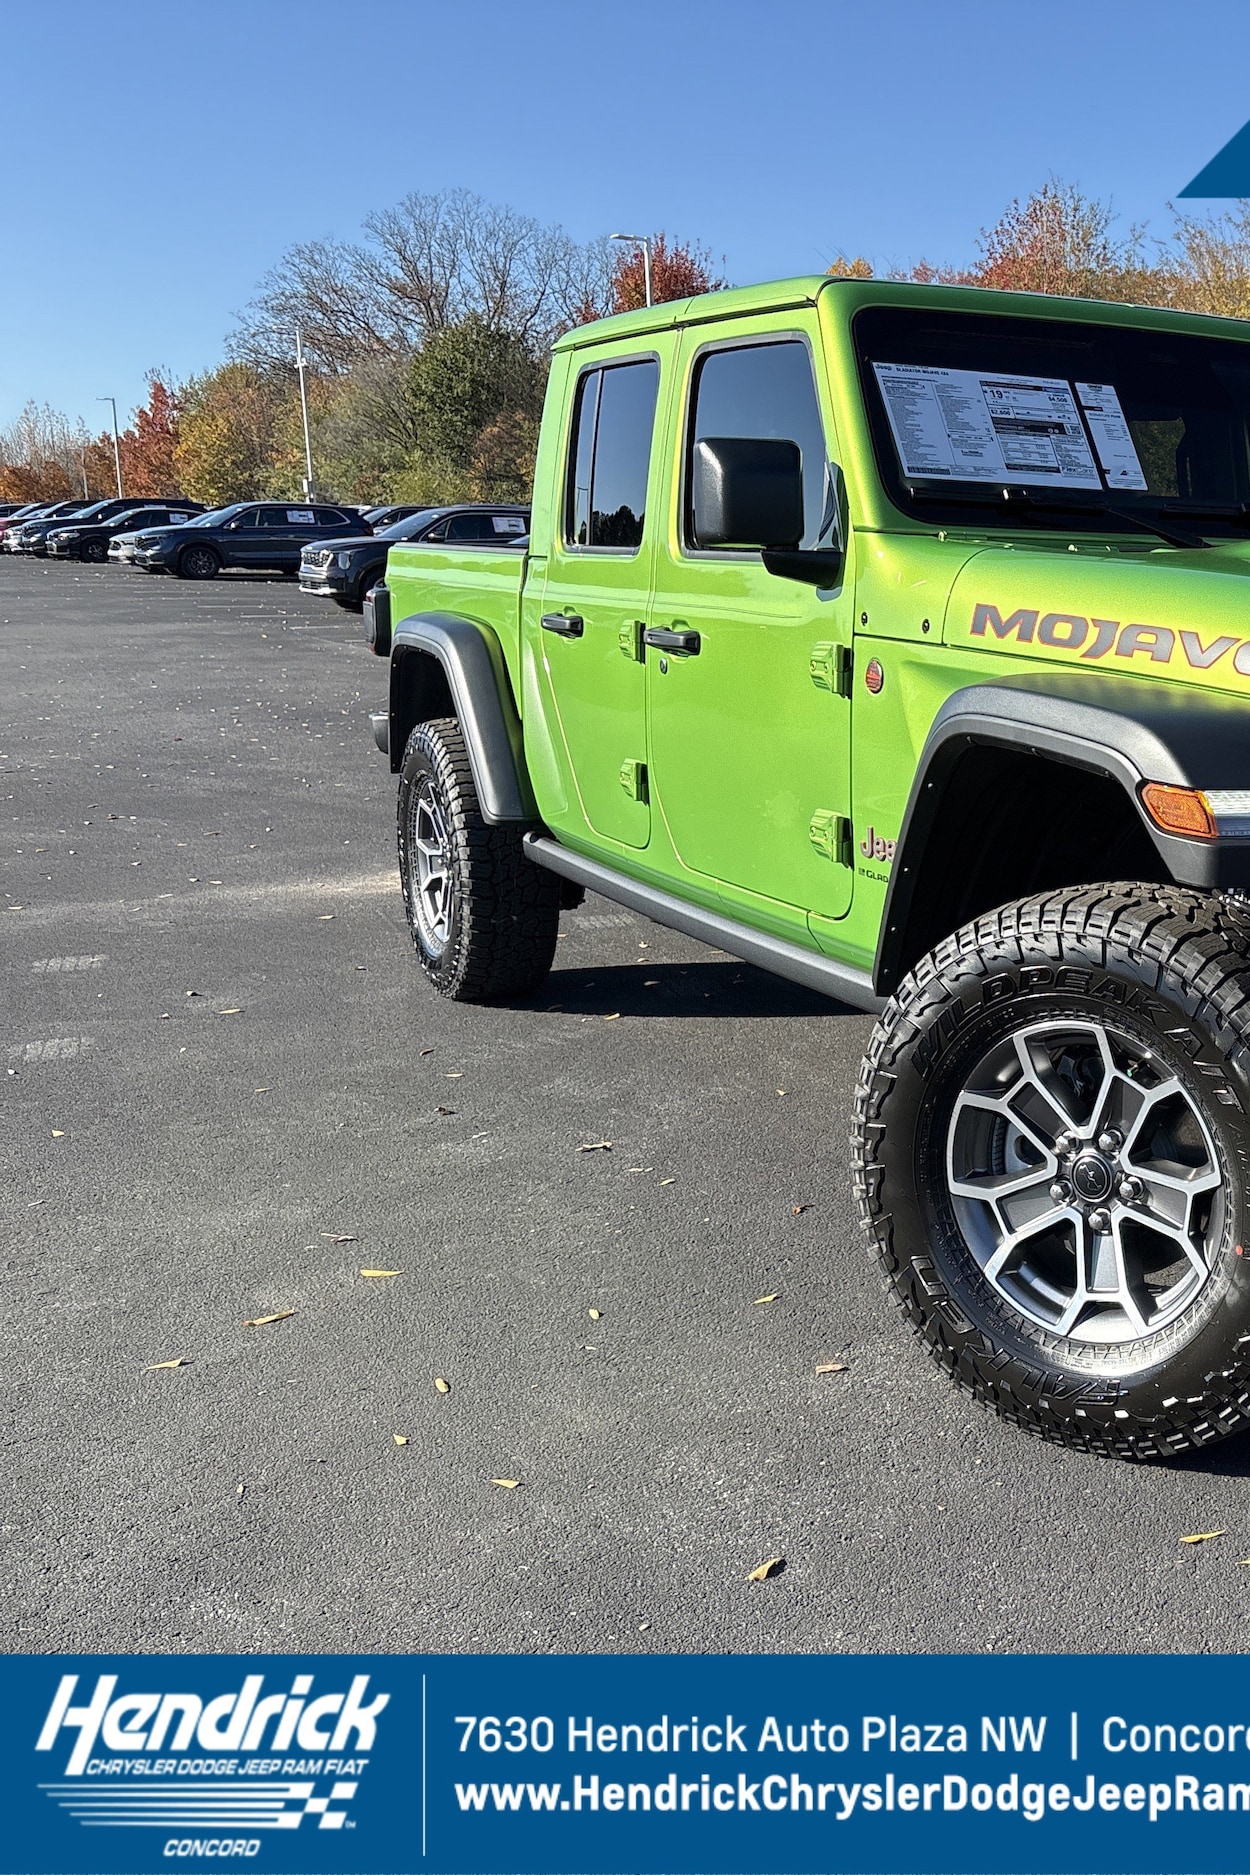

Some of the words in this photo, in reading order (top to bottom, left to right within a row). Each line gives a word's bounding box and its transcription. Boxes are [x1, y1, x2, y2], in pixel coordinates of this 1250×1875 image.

[860, 825, 898, 864] Jee
[866, 869, 889, 883] GLAD
[910, 964, 1173, 1081] WILDPEAK
[910, 1254, 1122, 1406] FALKEN
